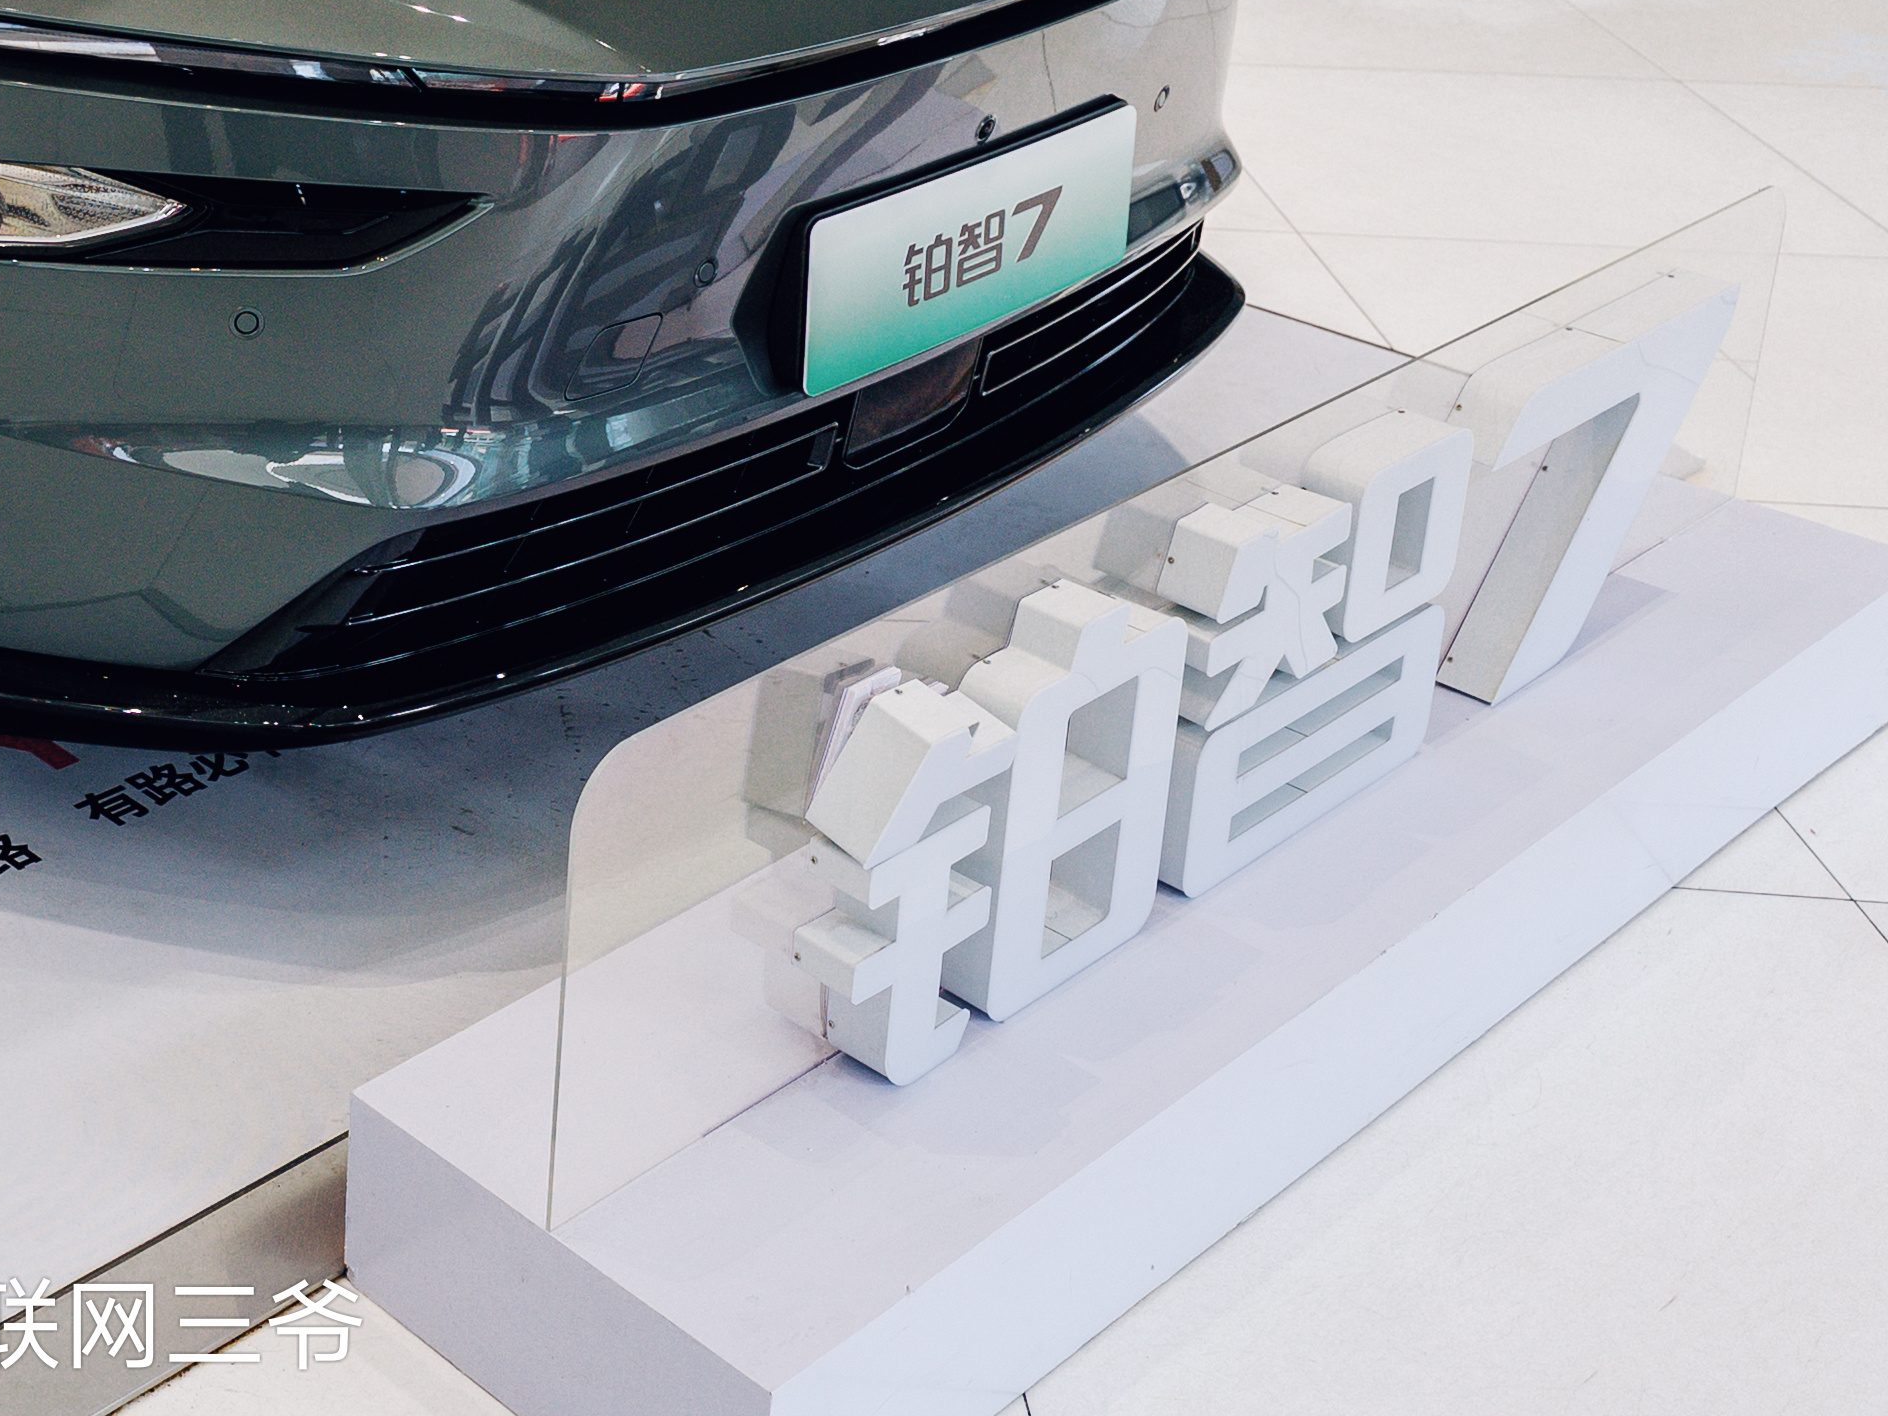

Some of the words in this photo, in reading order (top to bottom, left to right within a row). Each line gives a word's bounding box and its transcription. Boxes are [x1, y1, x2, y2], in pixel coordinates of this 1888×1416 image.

[901, 185, 1063, 308] 铂智7
[792, 274, 1738, 1087] 铂智7
[73, 750, 281, 827] 有路必
